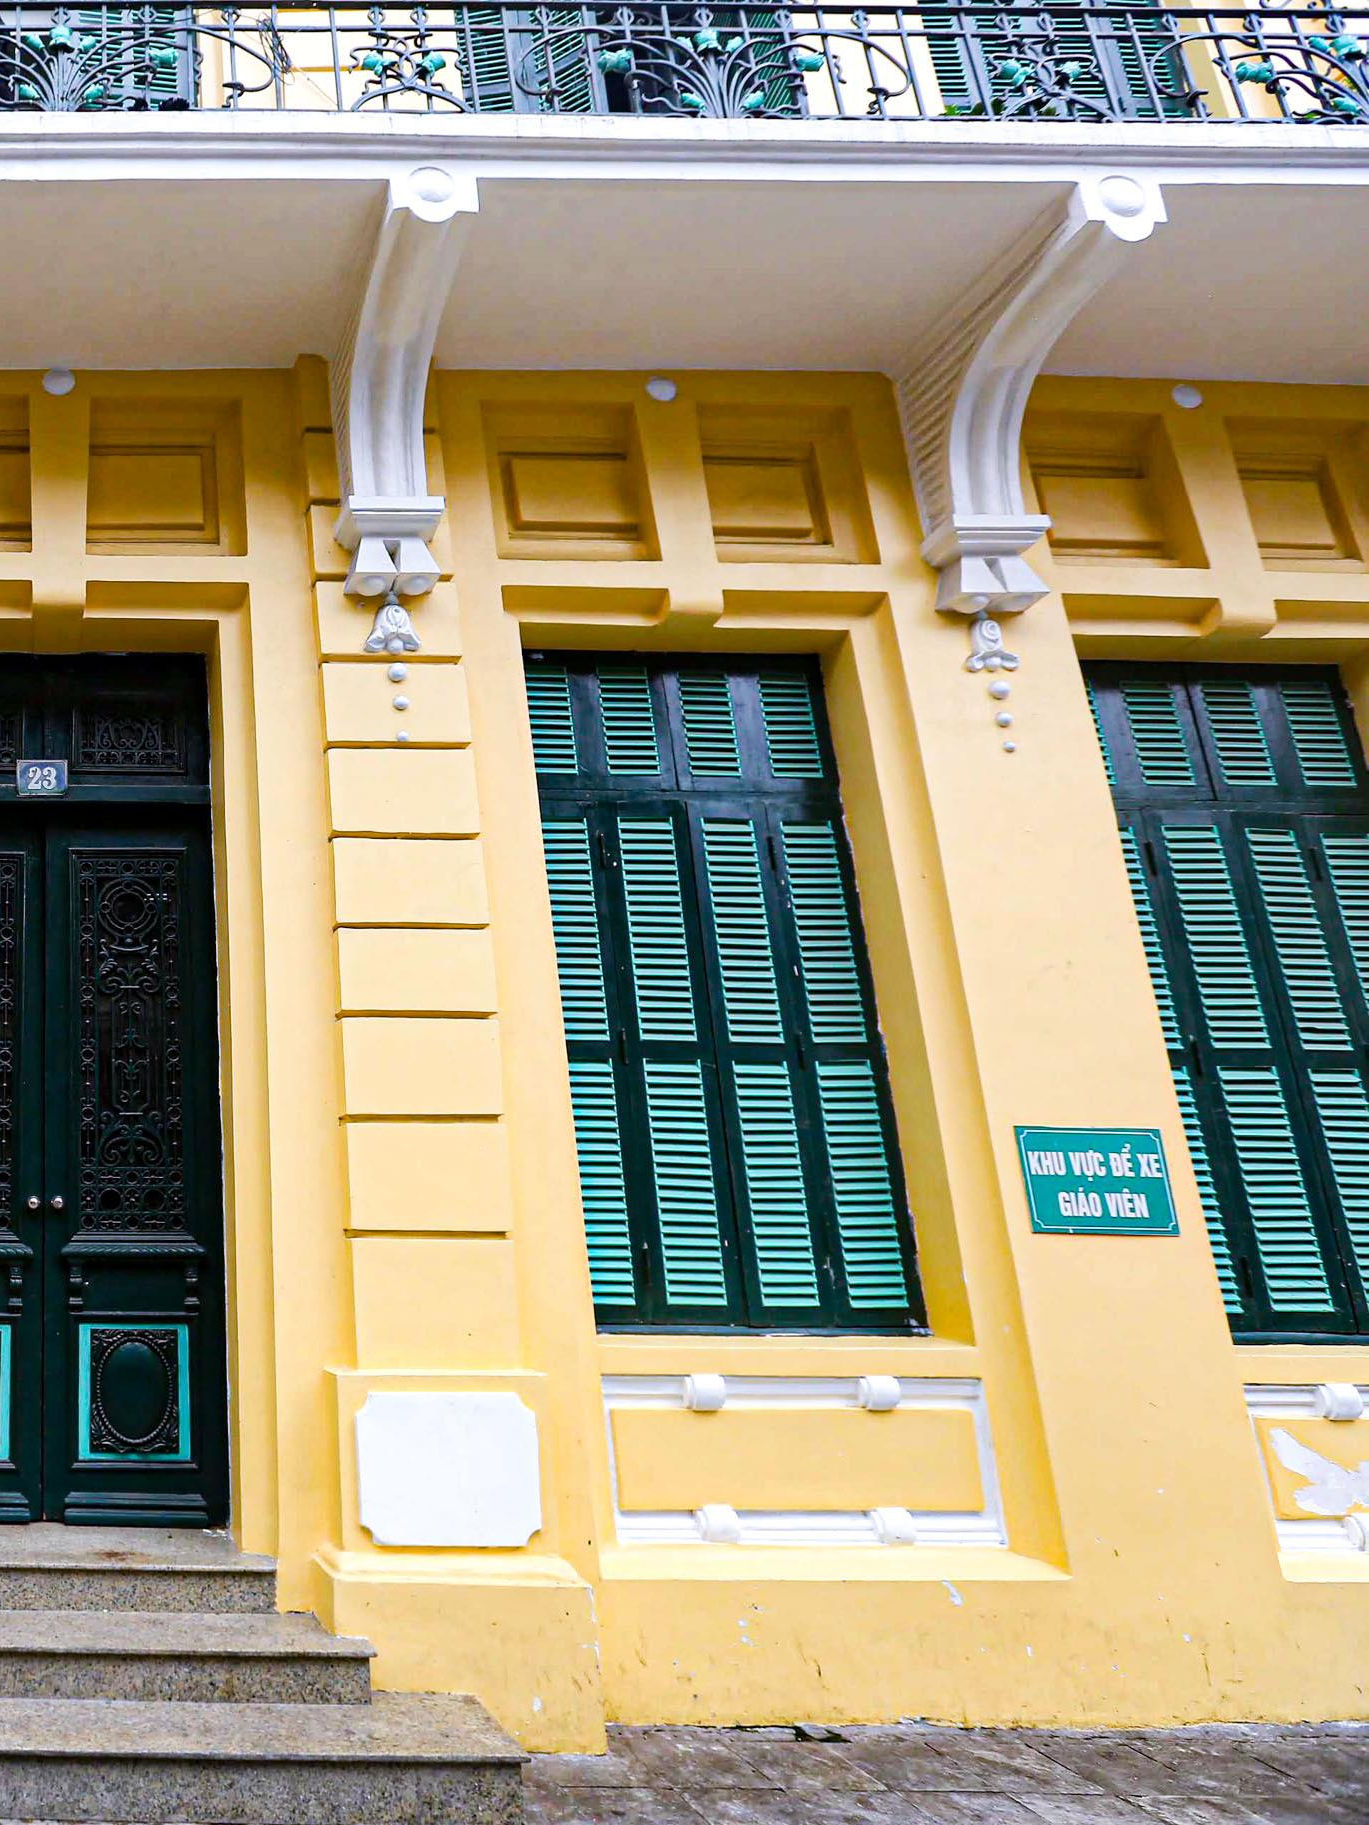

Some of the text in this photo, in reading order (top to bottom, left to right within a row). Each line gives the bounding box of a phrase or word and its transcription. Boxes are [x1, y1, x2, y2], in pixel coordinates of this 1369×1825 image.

[28, 767, 56, 790] 23
[1027, 1143, 1163, 1181] KHU VỰC ĐỂ XE
[1058, 1187, 1150, 1218] GIÁO VIÊN
